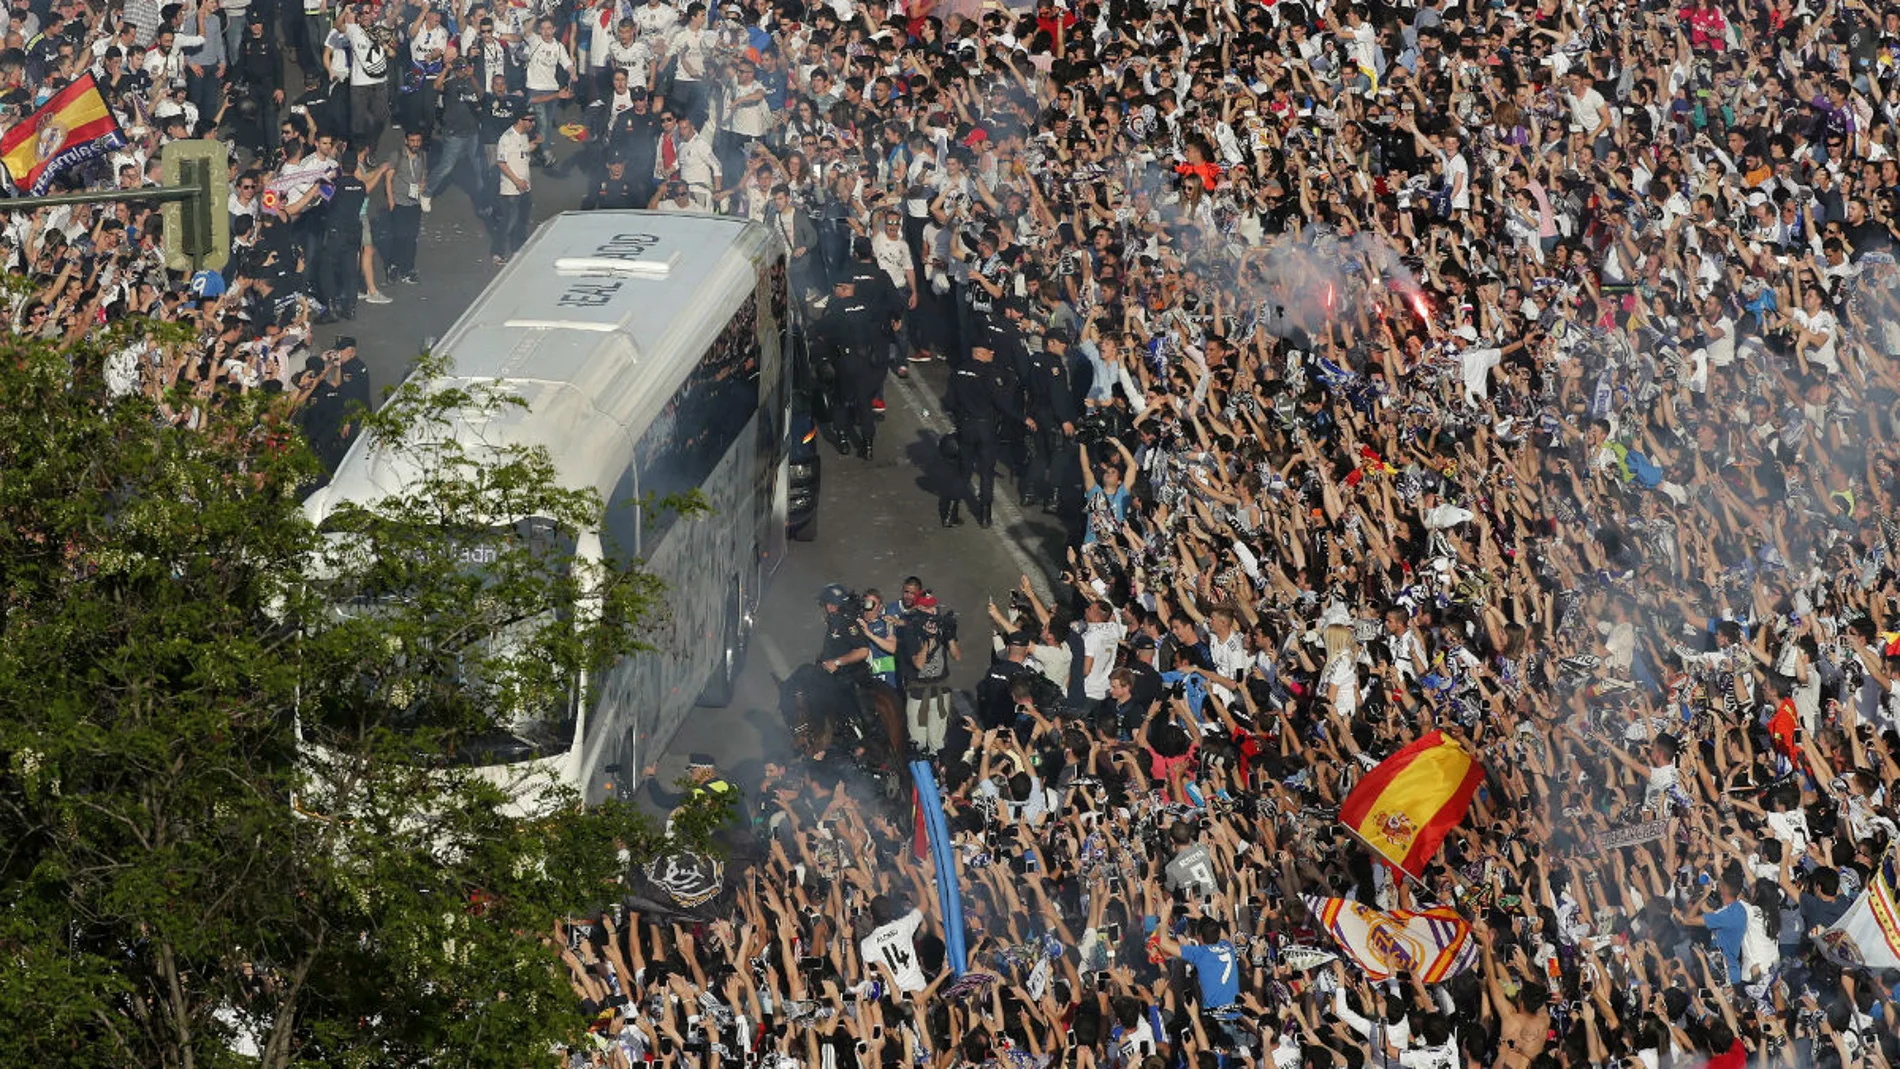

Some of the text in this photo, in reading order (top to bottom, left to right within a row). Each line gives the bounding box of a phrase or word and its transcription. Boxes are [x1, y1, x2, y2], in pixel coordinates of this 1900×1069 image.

[1190, 861, 1215, 890] 9
[881, 943, 911, 977] 14
[1217, 951, 1233, 985] 7
